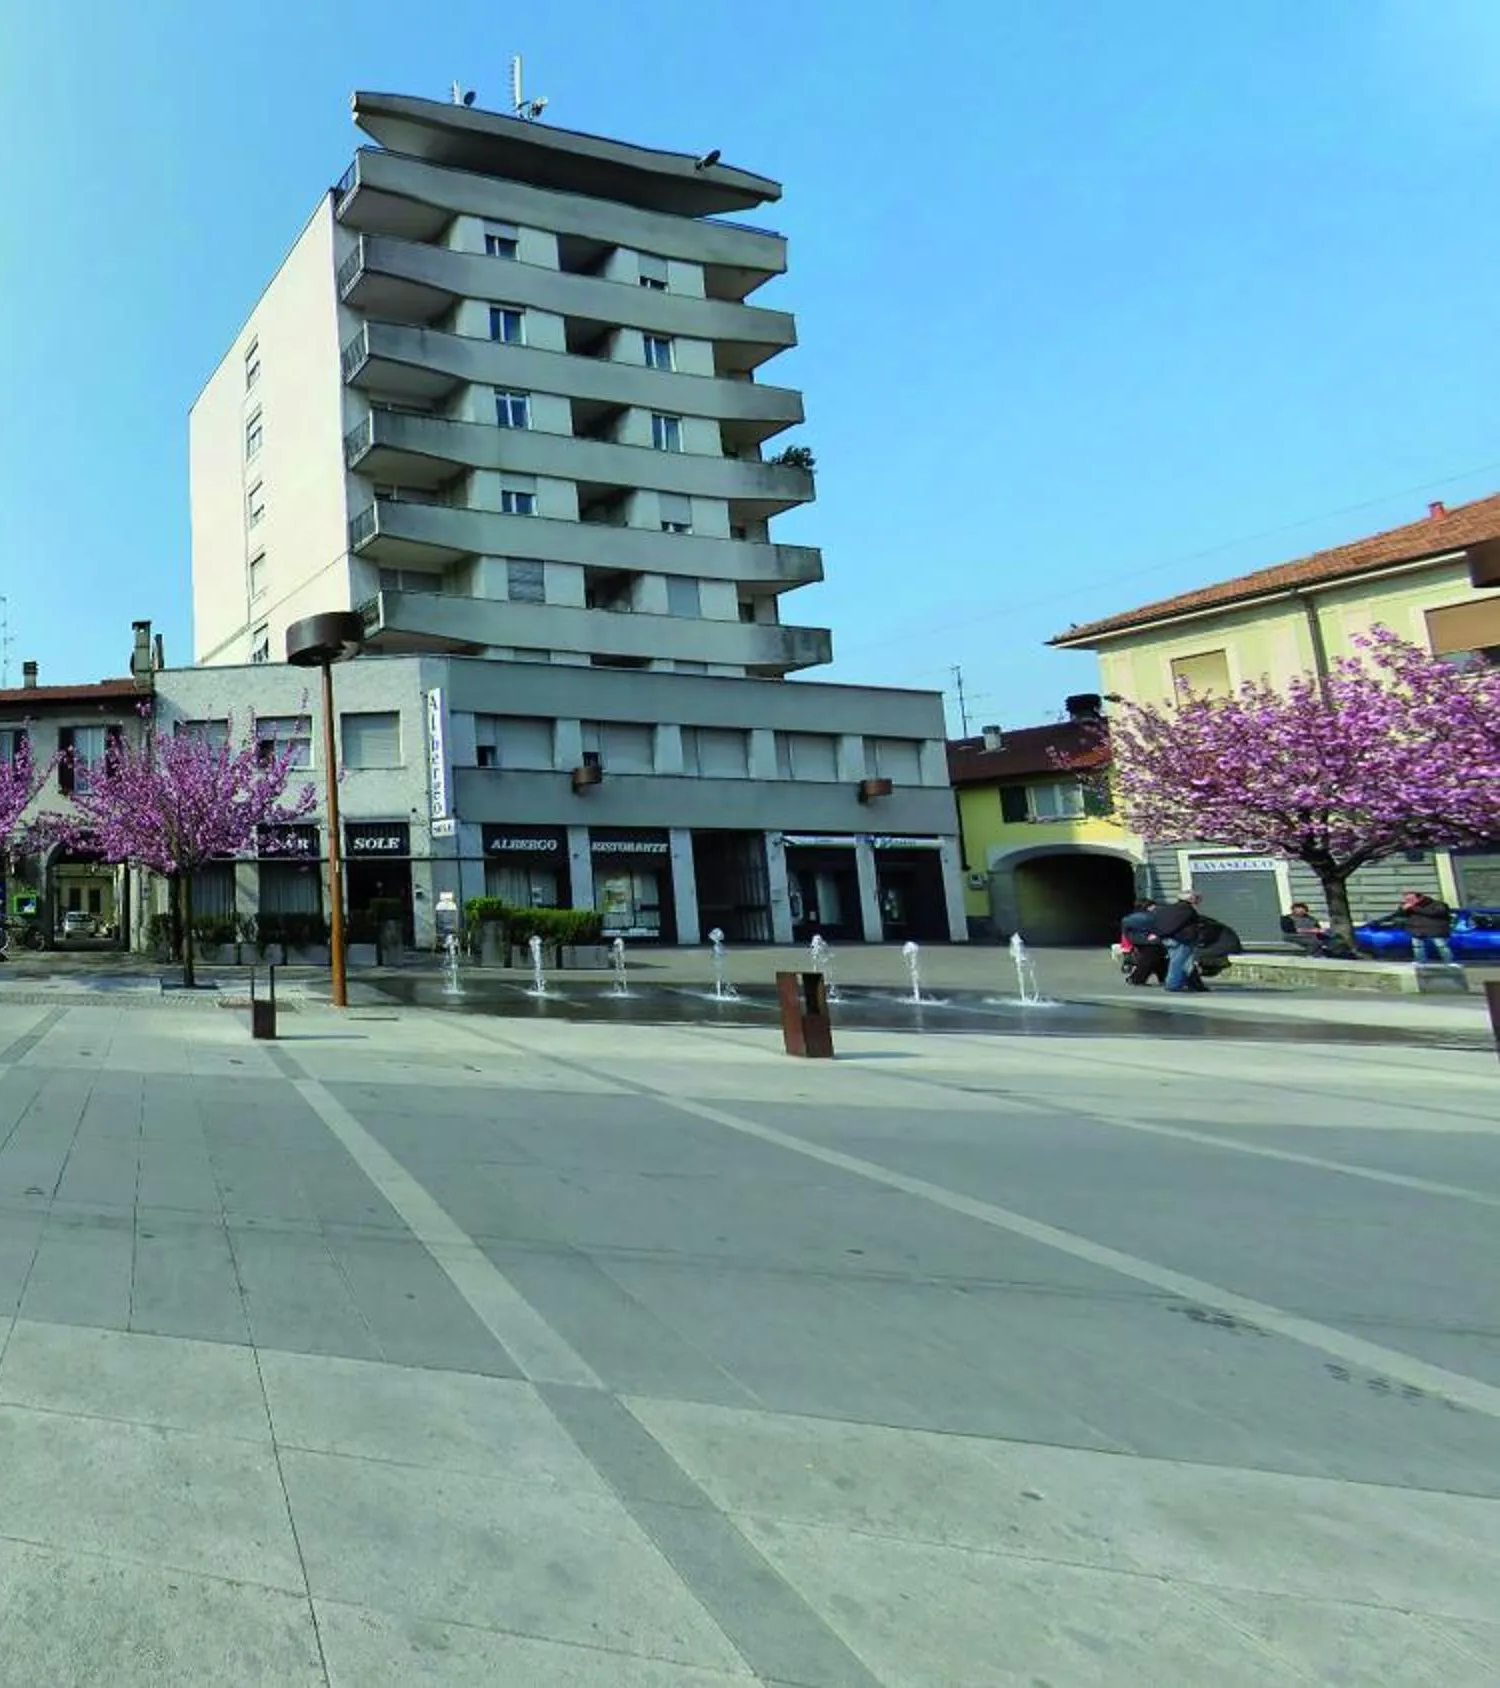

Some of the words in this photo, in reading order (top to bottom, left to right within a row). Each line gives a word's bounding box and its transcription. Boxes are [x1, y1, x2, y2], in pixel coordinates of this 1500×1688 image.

[353, 837, 401, 850] SOLE
[490, 838, 558, 851] ALBERGO
[591, 841, 669, 853] RISTORANTE
